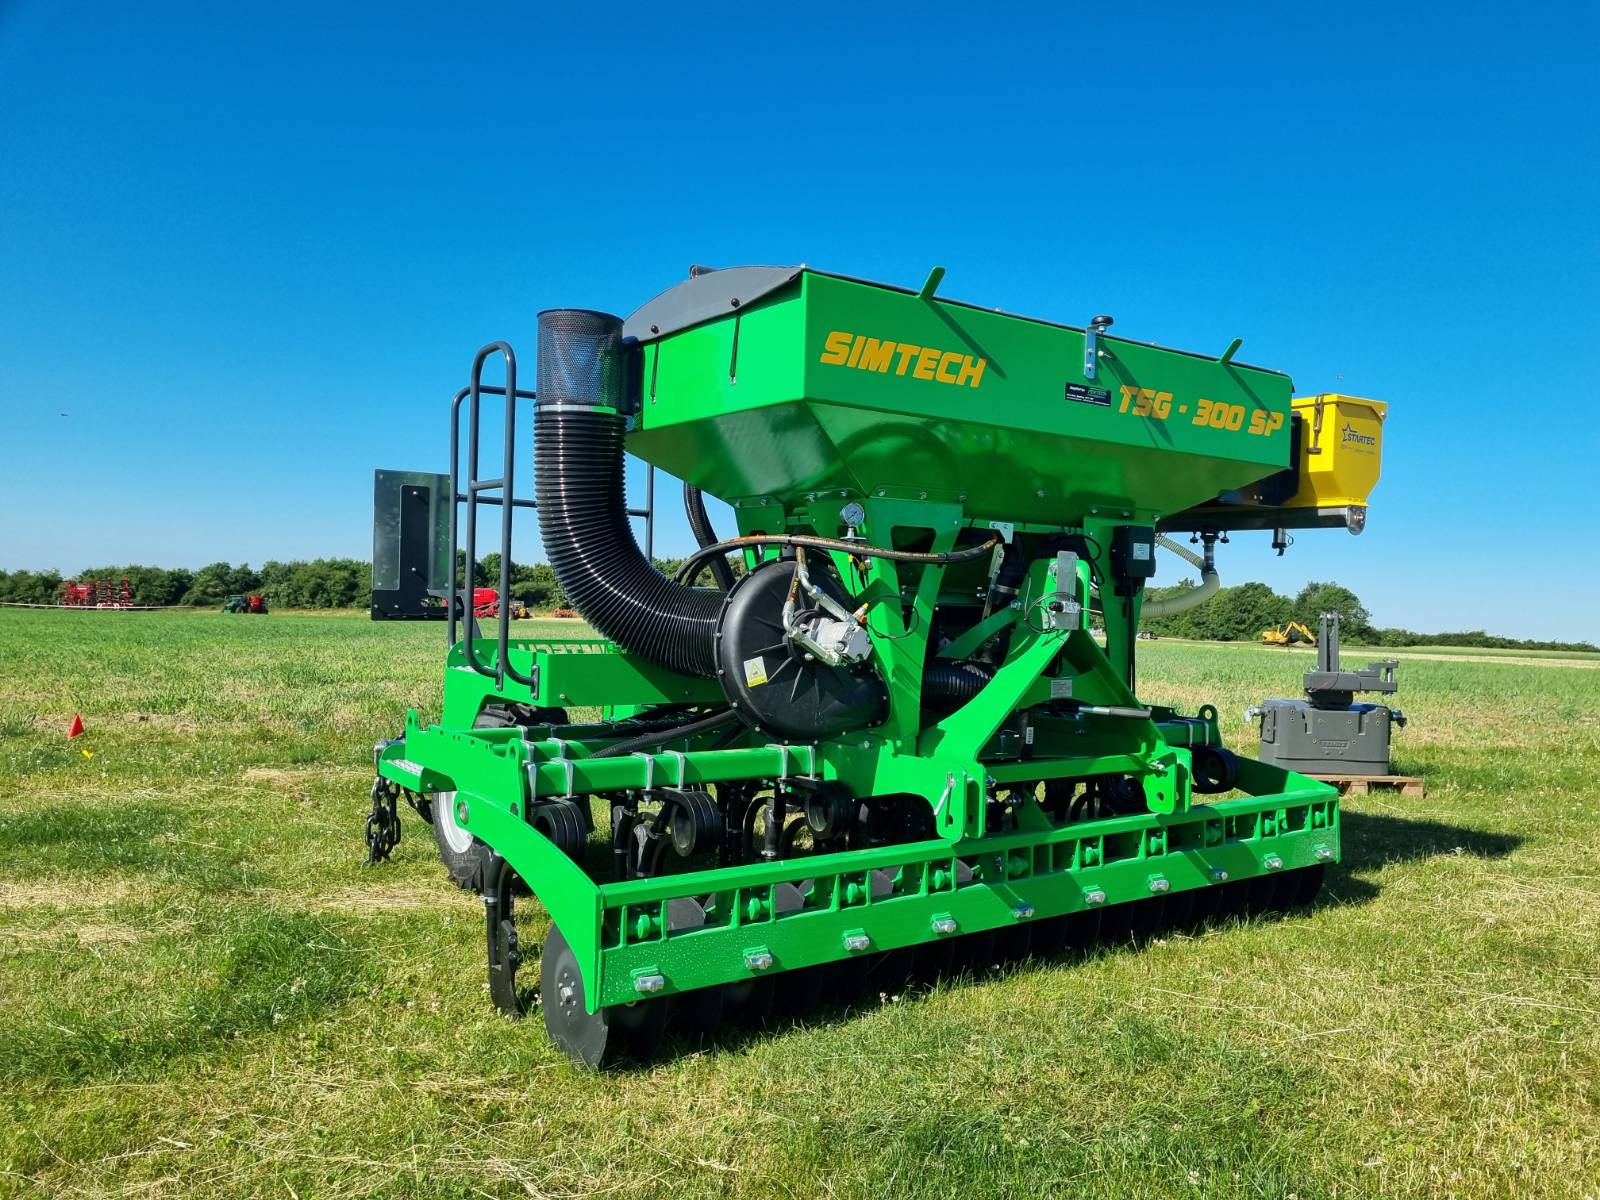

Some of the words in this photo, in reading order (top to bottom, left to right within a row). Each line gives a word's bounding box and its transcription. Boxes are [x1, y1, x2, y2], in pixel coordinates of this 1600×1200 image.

[820, 331, 987, 389] SIMTECH
[1119, 385, 1173, 420] TSG
[1192, 398, 1246, 432] 300
[1248, 408, 1284, 437] SP
[1347, 433, 1376, 446] STARTEC
